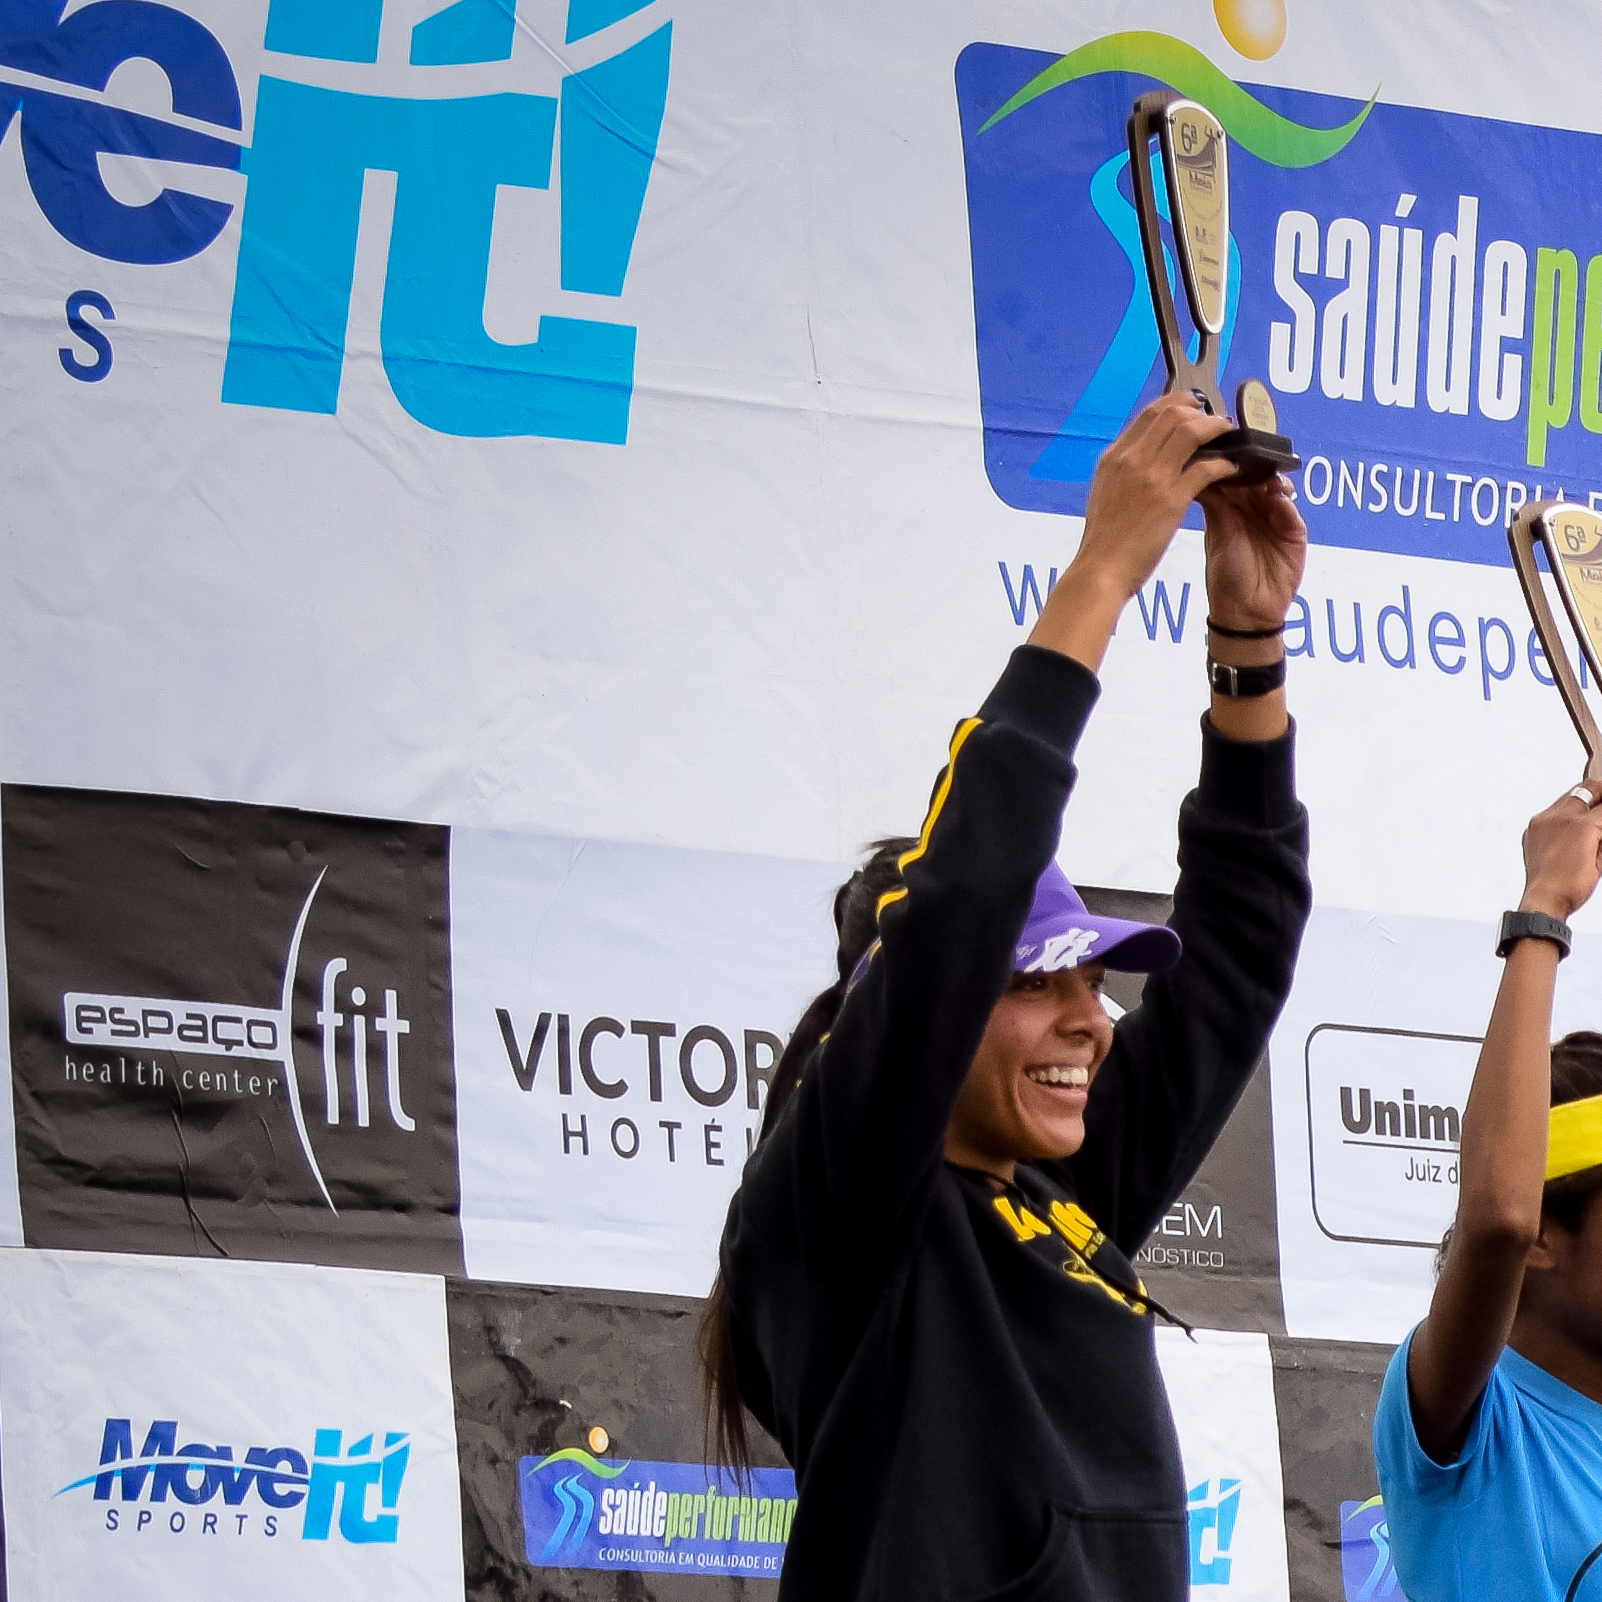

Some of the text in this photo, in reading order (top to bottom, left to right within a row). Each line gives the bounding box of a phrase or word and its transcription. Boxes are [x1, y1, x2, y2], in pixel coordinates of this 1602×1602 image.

[75, 957, 416, 1132] espaço fit
[495, 1008, 787, 1111] VICTOR
[64, 1056, 280, 1098] health center
[1340, 1086, 1462, 1142] Unim
[562, 1113, 752, 1167] HOTÉI
[1404, 1157, 1441, 1184] Juiz
[1137, 1244, 1224, 1268] NÓSTICO
[106, 1509, 279, 1538] SPORTS
[599, 1481, 798, 1548] saúdeperformanc
[598, 1547, 778, 1570] CONSULTORIA EM QUALIDADE DE
